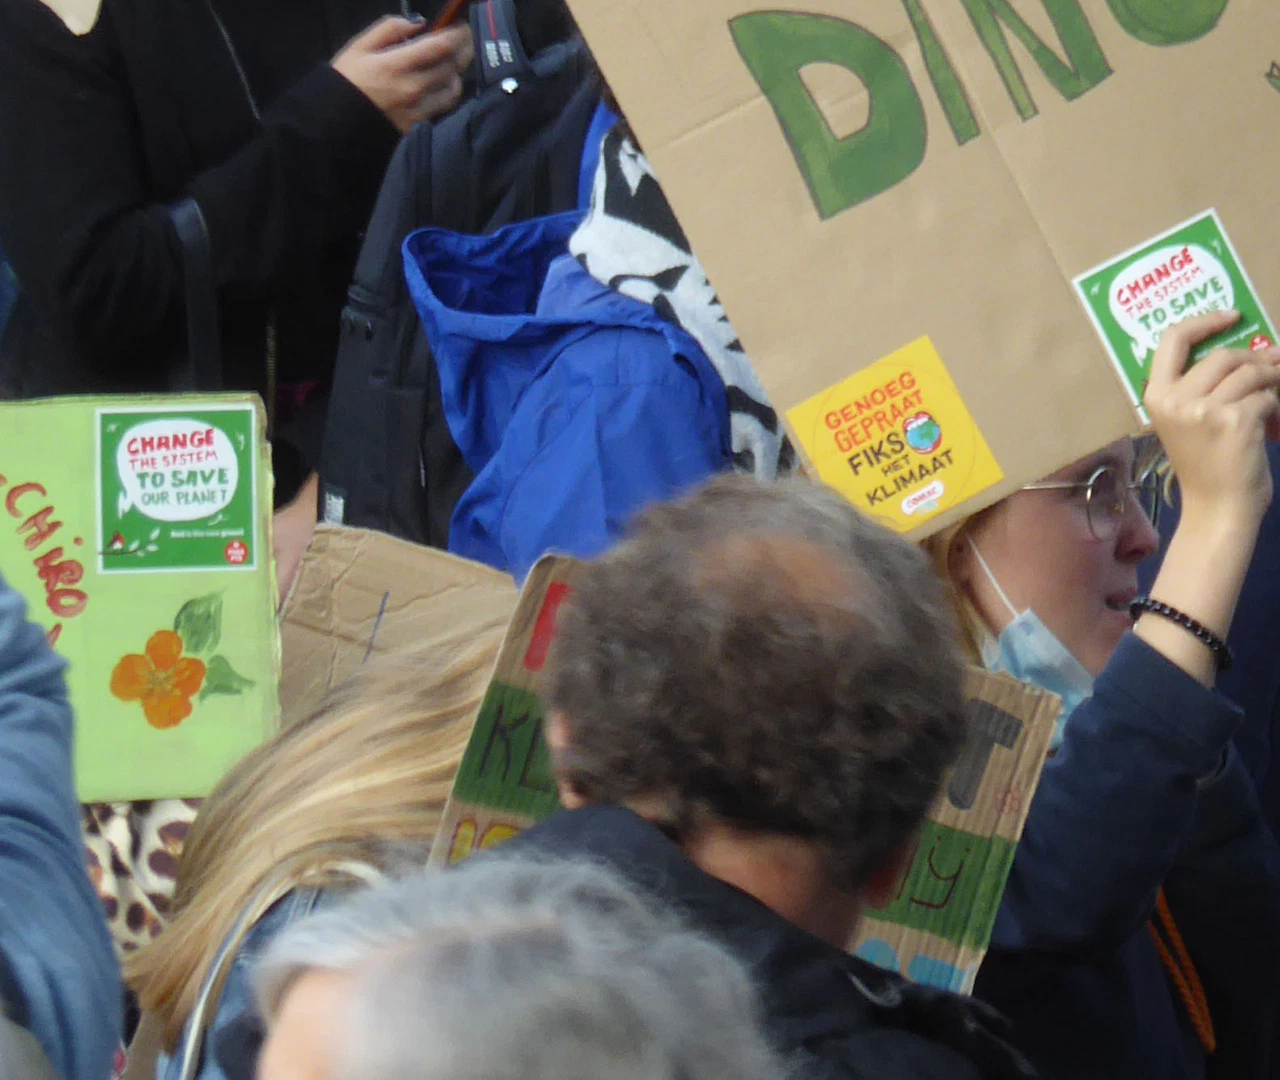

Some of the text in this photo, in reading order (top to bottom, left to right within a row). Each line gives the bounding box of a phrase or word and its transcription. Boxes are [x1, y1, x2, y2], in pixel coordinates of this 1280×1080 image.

[1116, 246, 1194, 307] CHANGE
[1126, 266, 1205, 320] THE SYSTEM
[1138, 276, 1224, 332] TO SAVE
[824, 371, 917, 431] GENOEG
[834, 389, 924, 454] GEPRAAT
[127, 428, 215, 455] CHANGE
[129, 450, 219, 471] THE SYSTEM
[847, 431, 905, 476] FIKS
[881, 454, 911, 477] HET
[136, 468, 230, 489] TO SAVE
[141, 489, 228, 506] OUR PLANET
[866, 449, 955, 507] KLIMAAT
